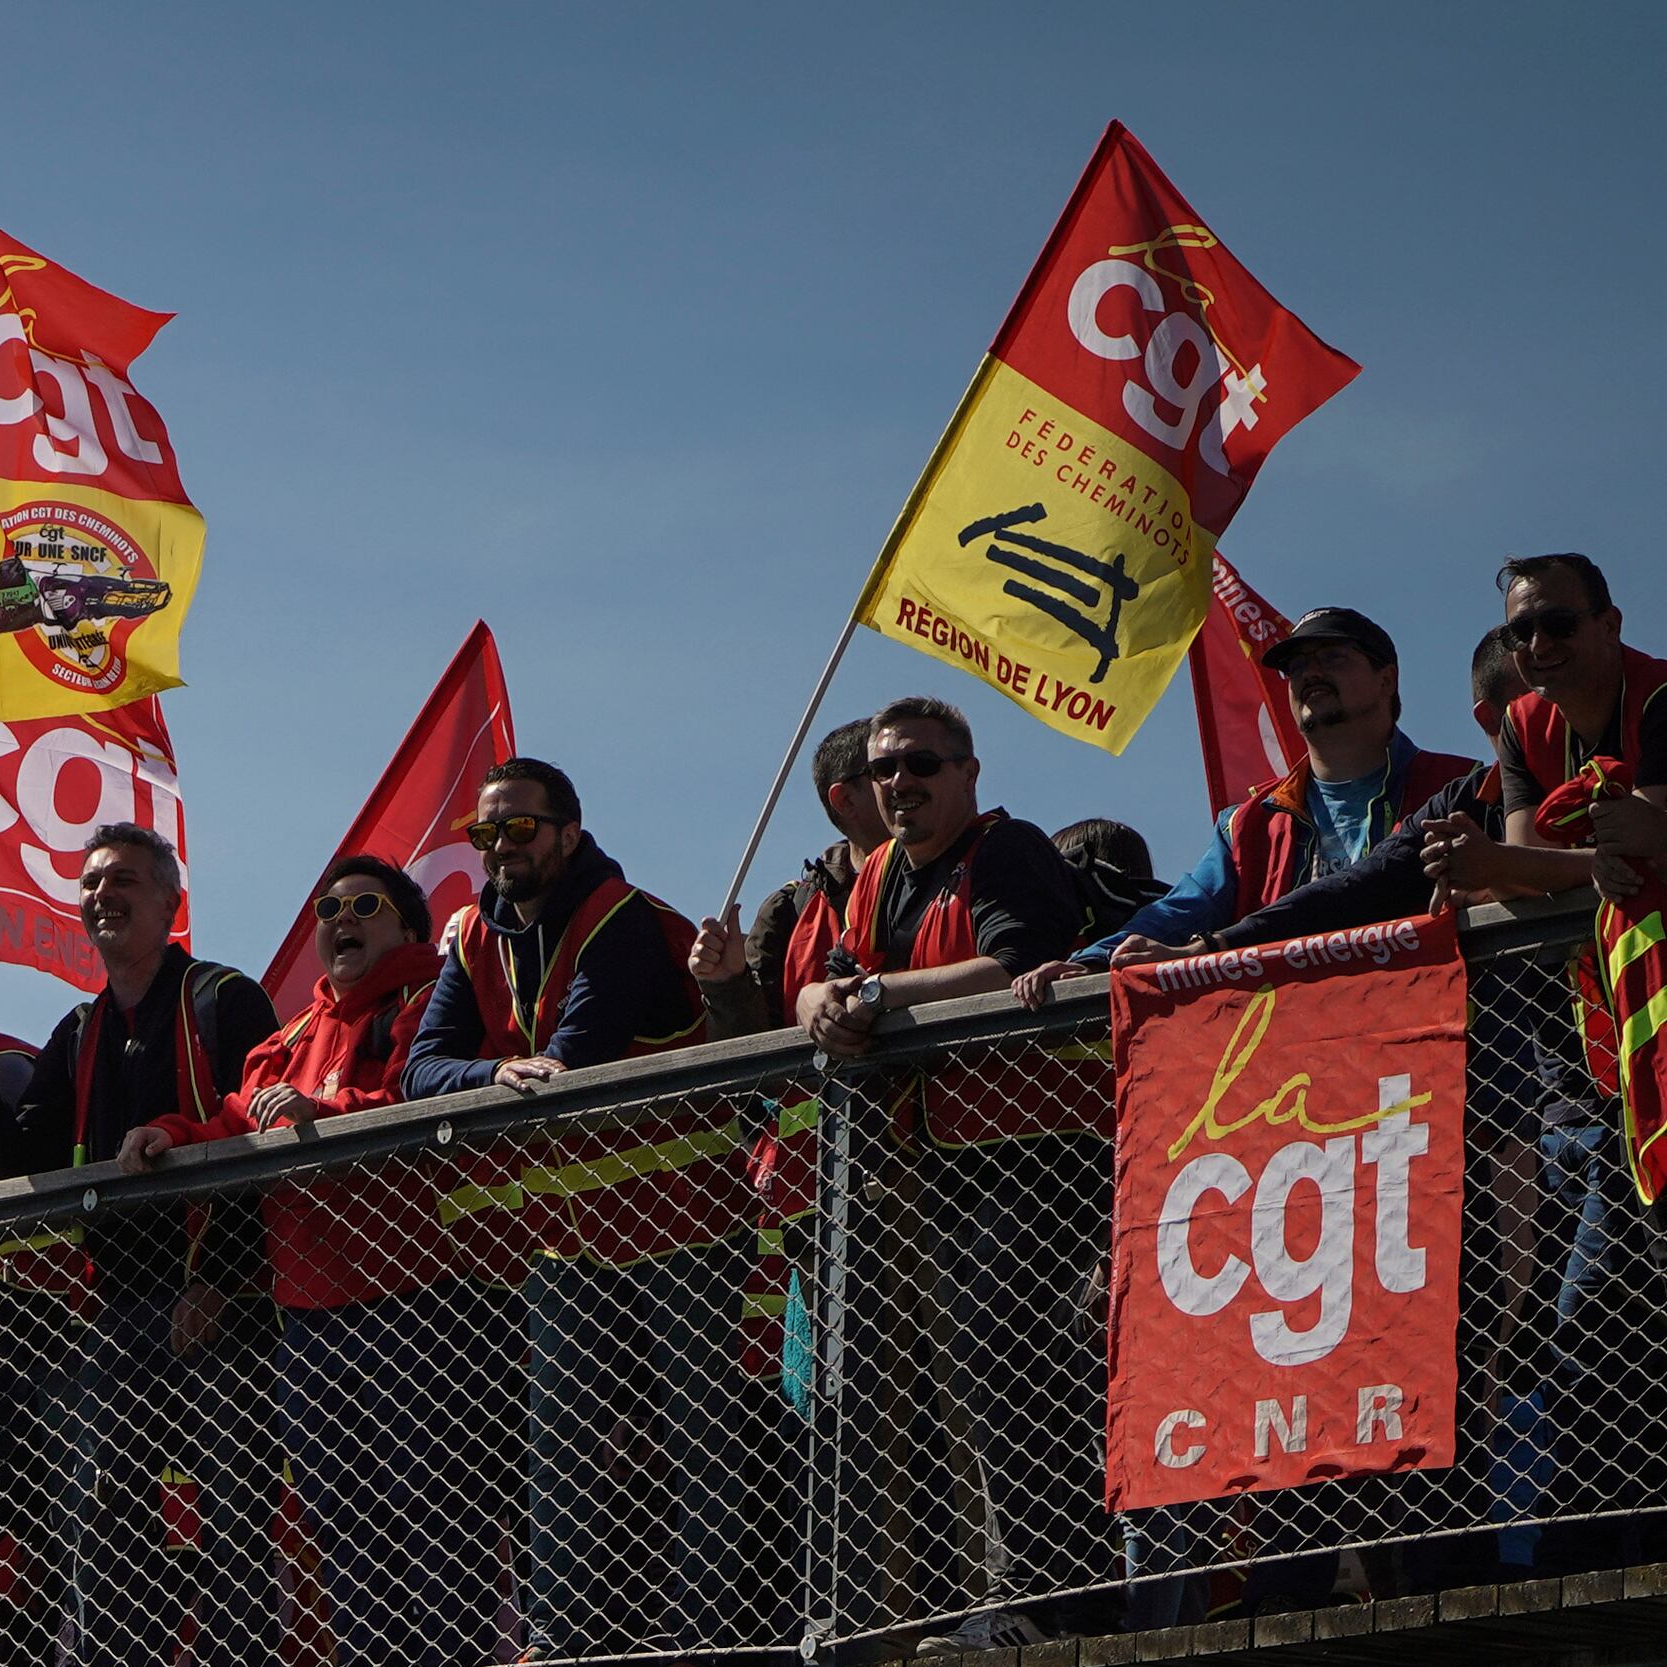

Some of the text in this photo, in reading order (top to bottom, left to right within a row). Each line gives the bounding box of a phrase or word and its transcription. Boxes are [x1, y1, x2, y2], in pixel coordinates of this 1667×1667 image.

[1068, 259, 1267, 478] cgt
[31, 506, 52, 519] CGT
[54, 507, 77, 523] DES
[78, 515, 139, 564] CHEMINOTS
[38, 543, 65, 560] UNE
[71, 546, 107, 563] SNCF
[39, 525, 65, 543] cgt
[1006, 431, 1190, 567] DES CHEMINOTS
[896, 598, 1117, 731] RÉGION DE LYON
[1168, 983, 1433, 1161] la
[1156, 1072, 1431, 1368] cgt
